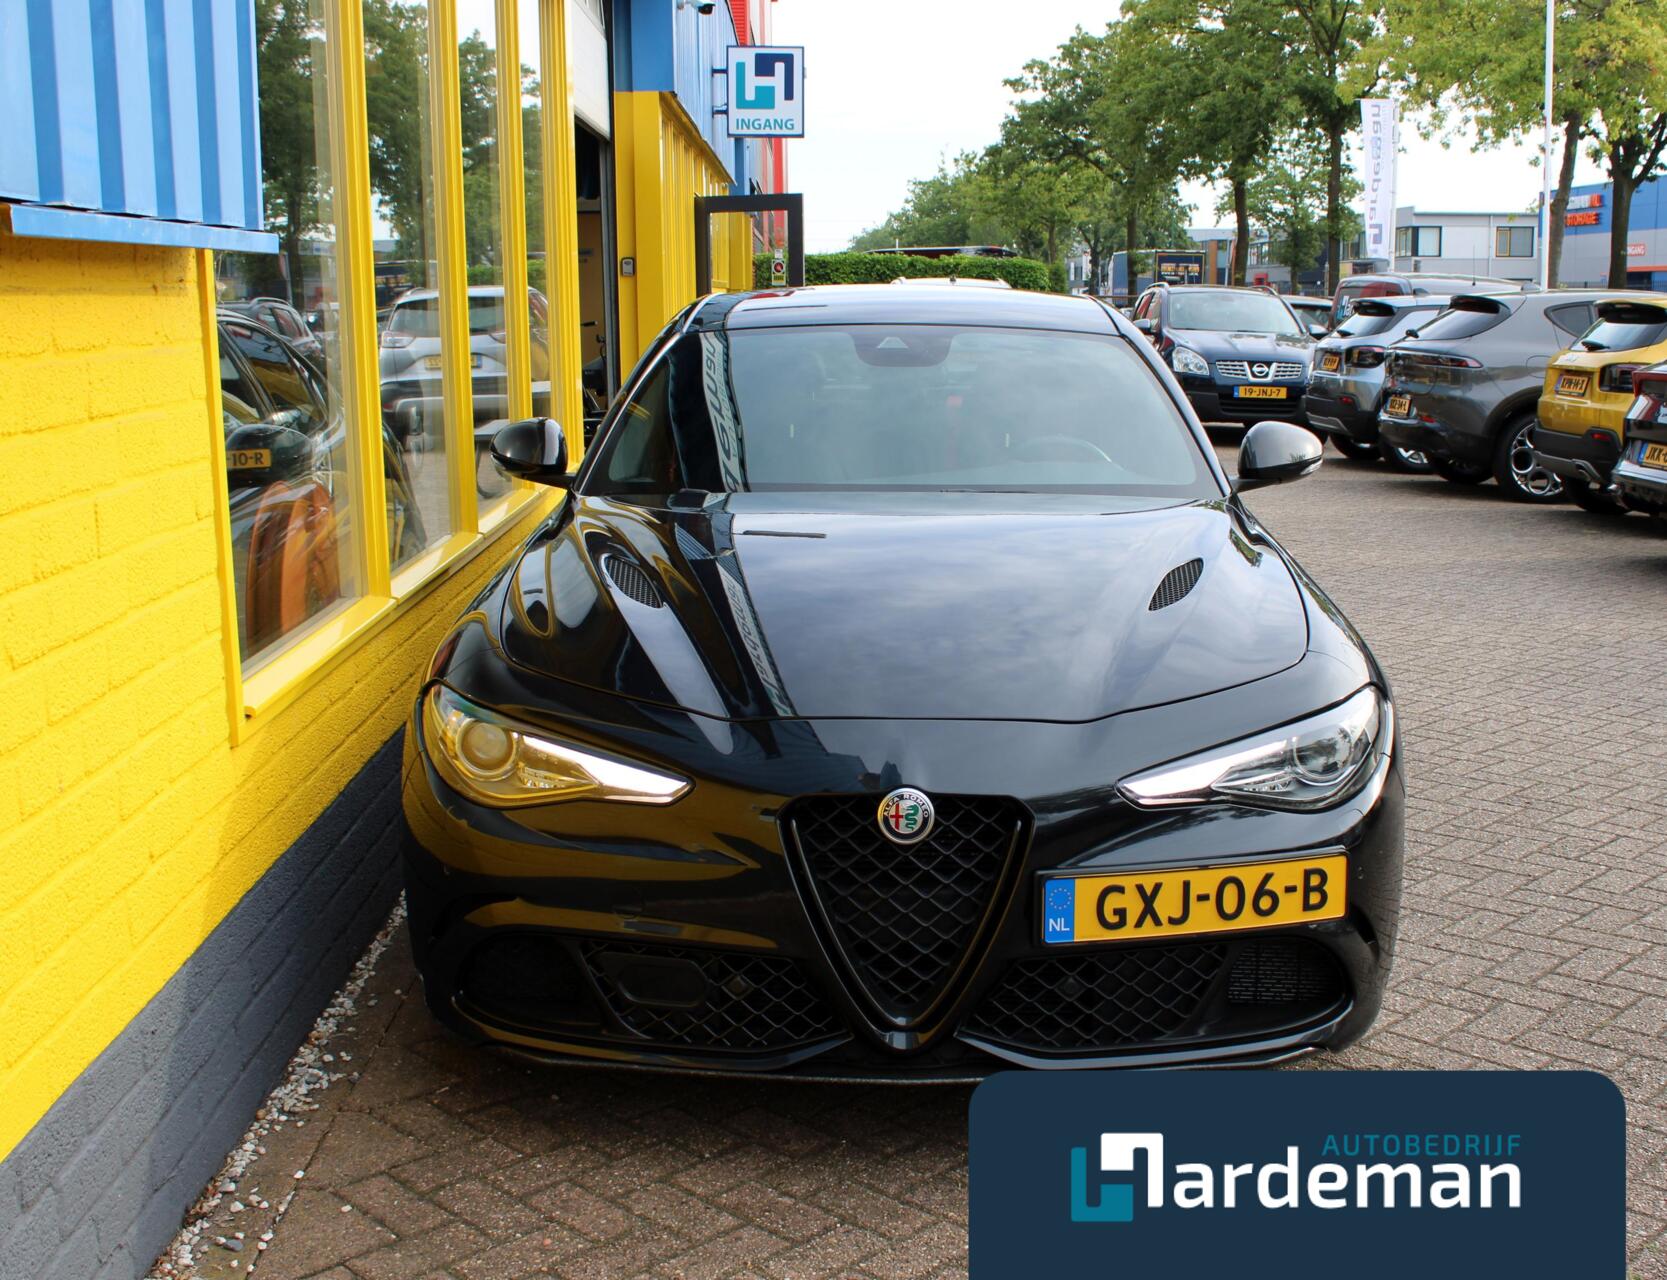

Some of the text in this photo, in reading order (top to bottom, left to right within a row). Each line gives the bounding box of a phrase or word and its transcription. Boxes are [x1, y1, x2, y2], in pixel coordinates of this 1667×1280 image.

[736, 118, 794, 131] INGANG
[1244, 387, 1281, 397] 19-JNJ-7
[884, 793, 929, 818] ALFA ROMEO
[1048, 867, 1329, 932] NL GXJ-06-B
